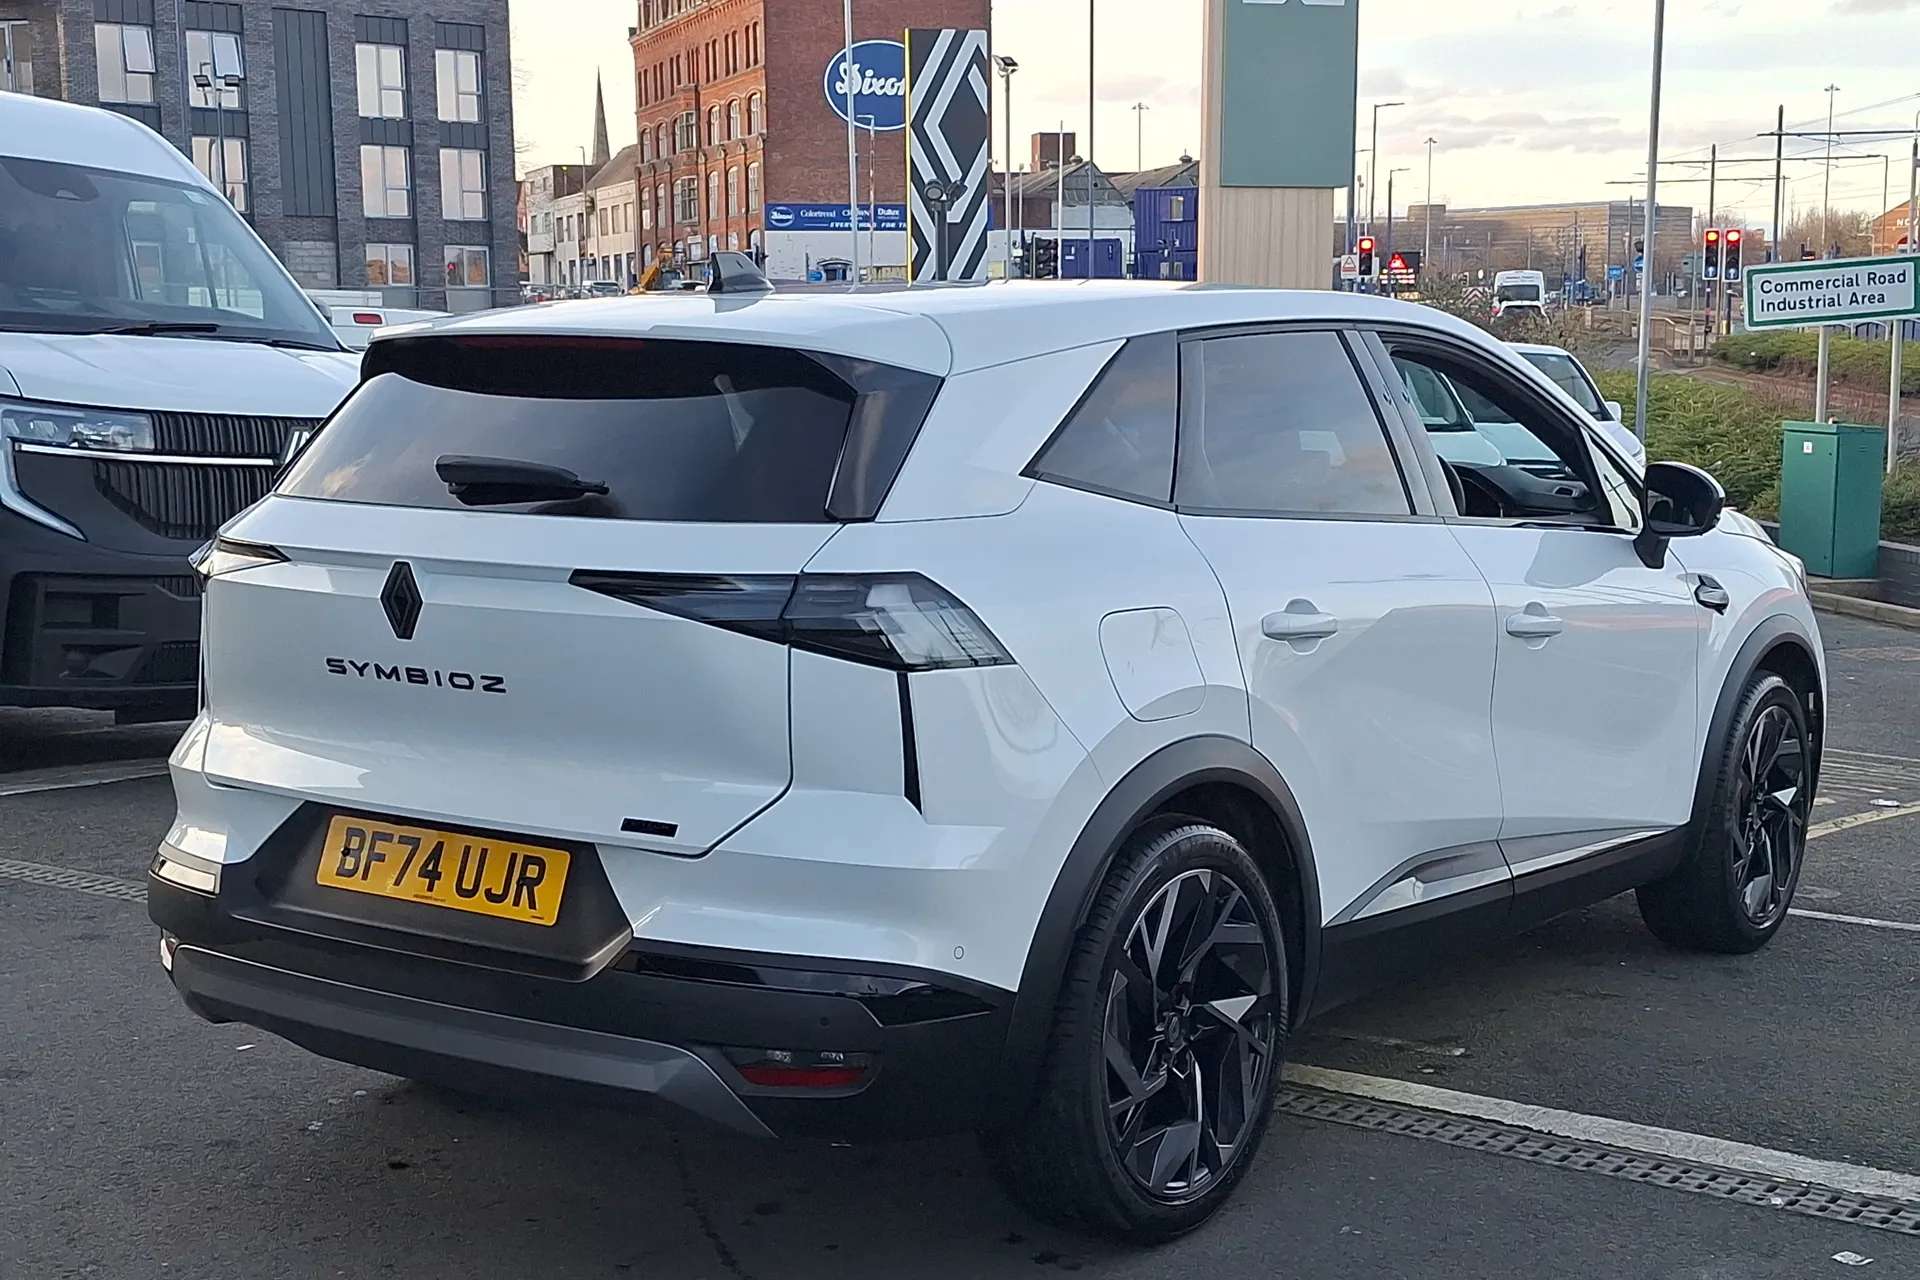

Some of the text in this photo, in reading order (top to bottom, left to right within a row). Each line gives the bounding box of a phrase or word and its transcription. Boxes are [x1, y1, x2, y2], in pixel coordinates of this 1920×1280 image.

[1760, 269, 1907, 294] Commercial Road
[1760, 292, 1885, 312] Industrial Area
[326, 657, 507, 694] SYMBIOZ
[335, 827, 547, 911] BF74 UJR
